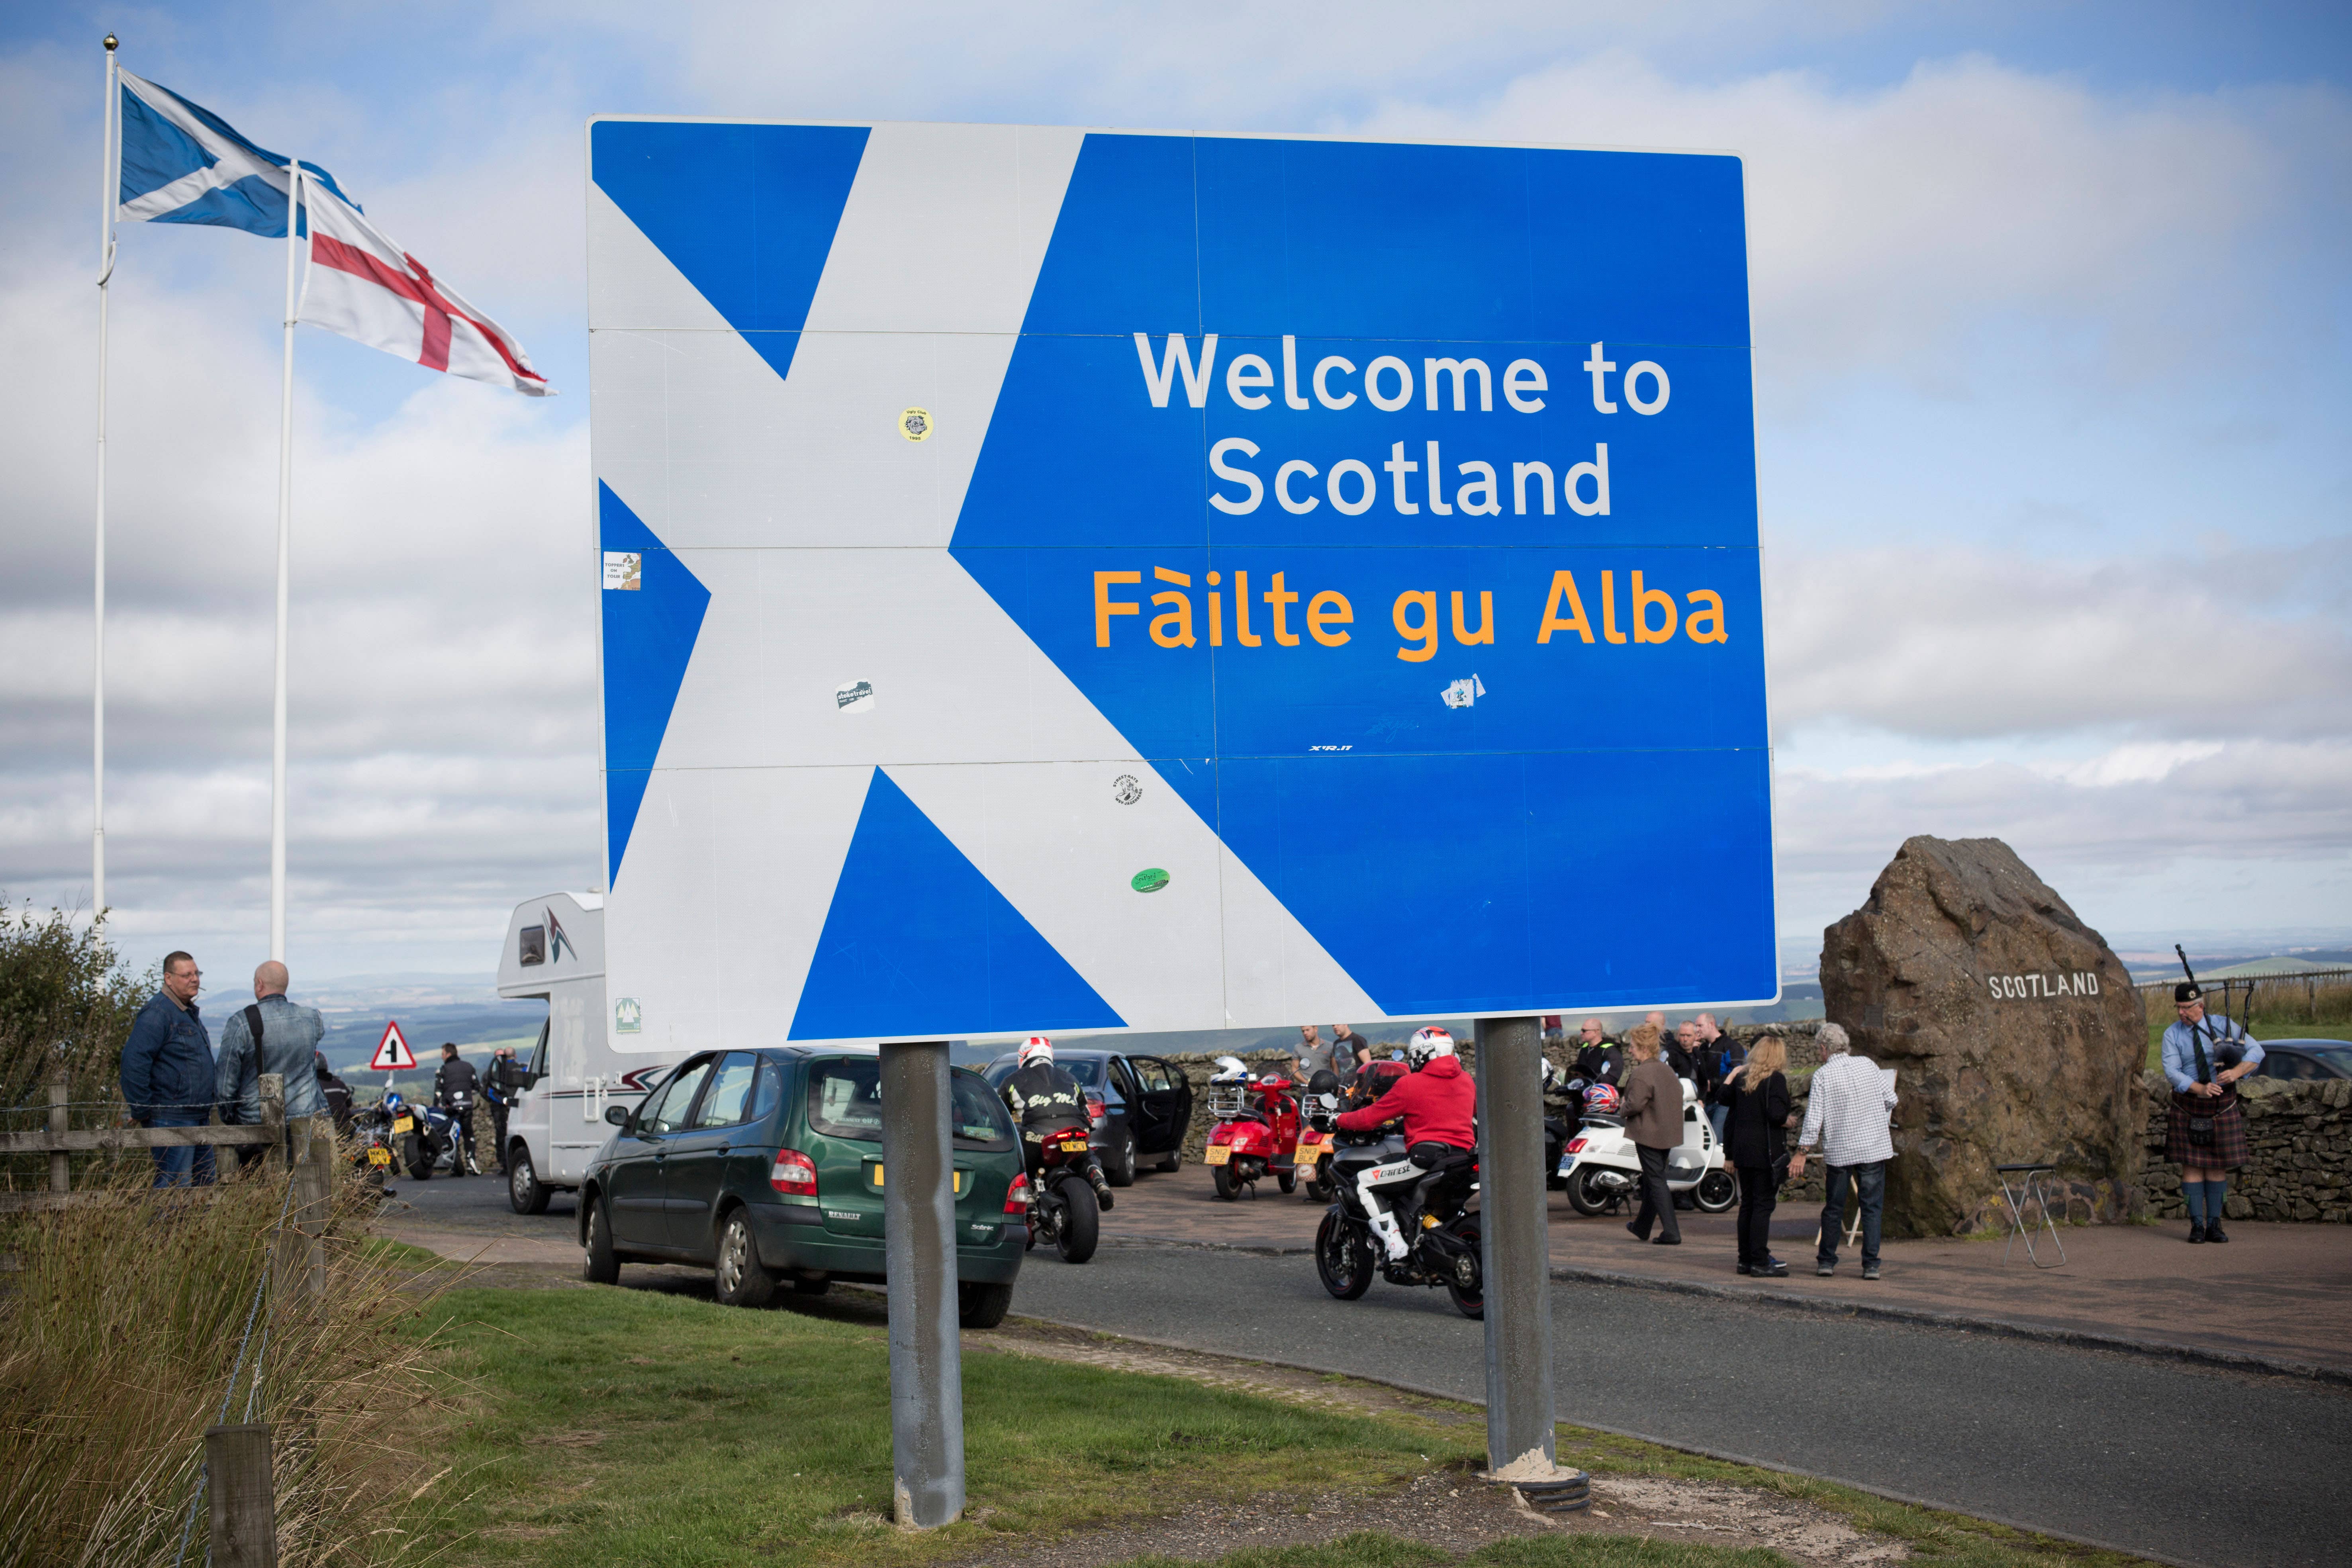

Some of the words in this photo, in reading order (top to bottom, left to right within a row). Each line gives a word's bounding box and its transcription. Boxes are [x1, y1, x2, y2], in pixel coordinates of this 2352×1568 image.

[1134, 333, 1547, 413] Welcome
[1584, 341, 1670, 415] to
[1209, 438, 1610, 516] Scotland
[1094, 566, 1353, 648] Fàilte
[1393, 591, 1494, 662] gu
[1537, 570, 1728, 644] Alba
[1989, 972, 2099, 999] SCOTLAND
[1028, 1094, 1052, 1107] Big
[828, 1211, 860, 1220] RENAULT
